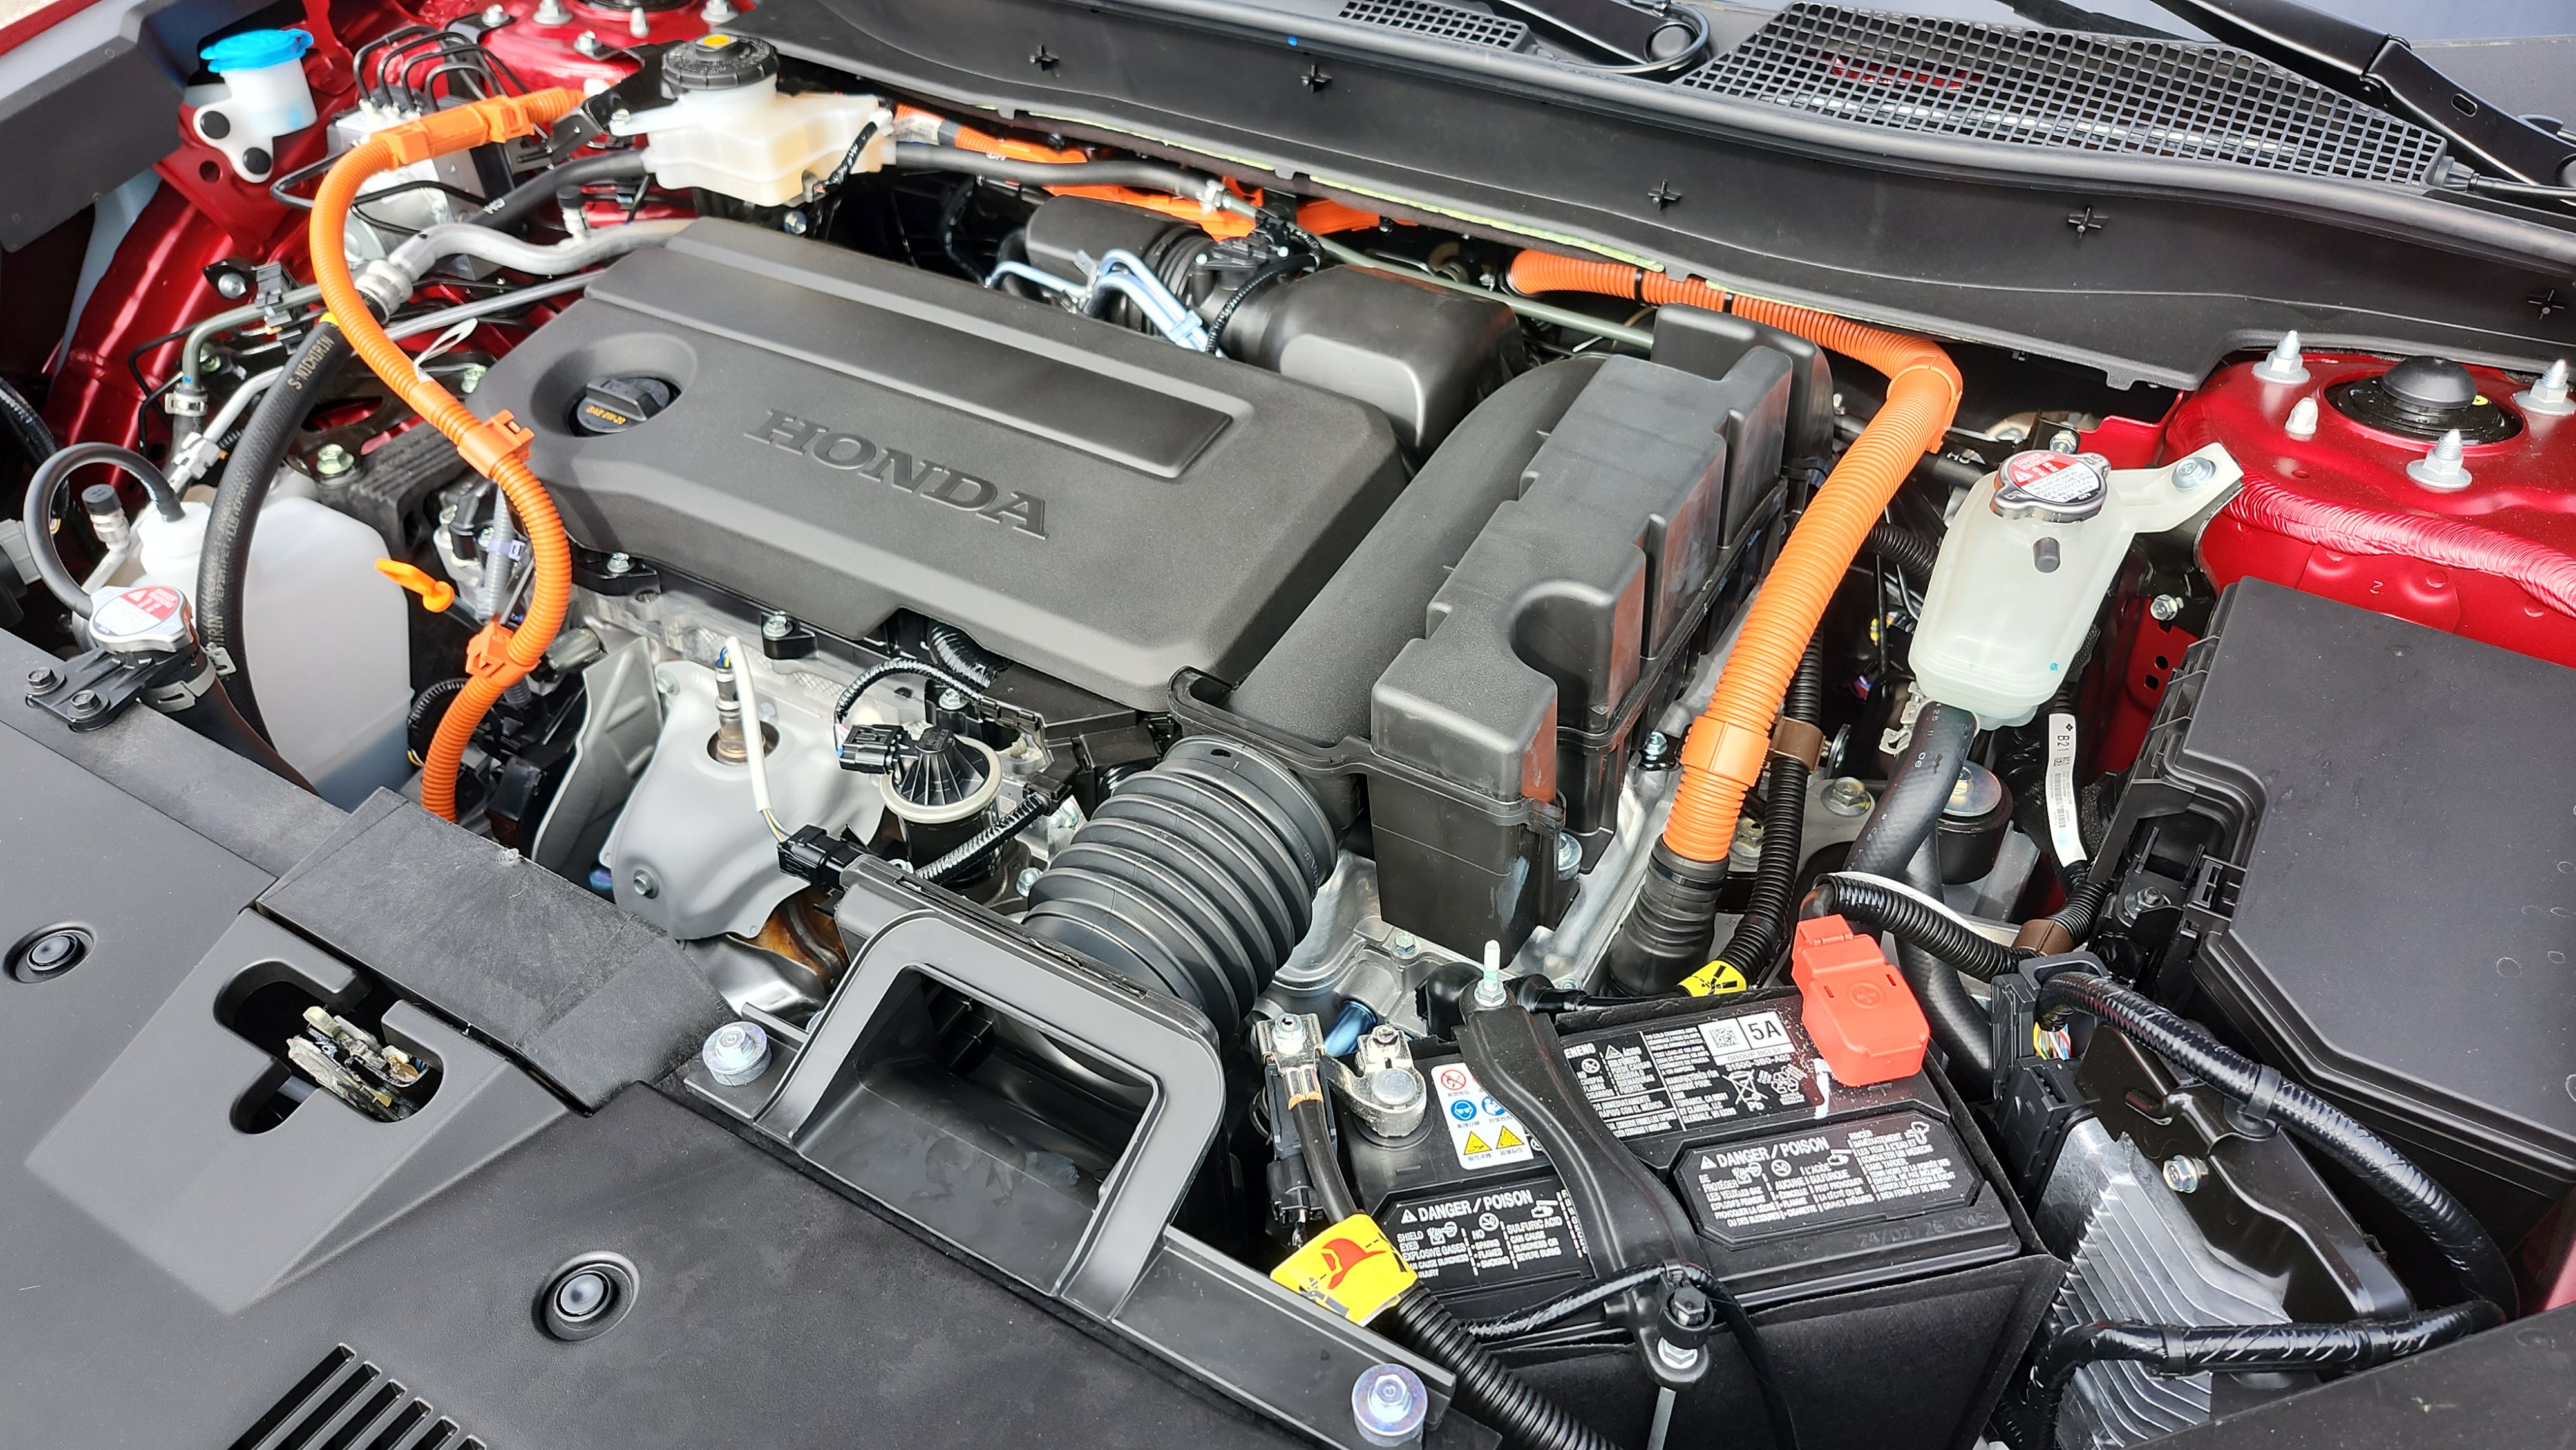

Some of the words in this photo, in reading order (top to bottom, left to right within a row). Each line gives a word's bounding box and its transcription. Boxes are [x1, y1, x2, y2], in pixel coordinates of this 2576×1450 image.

[743, 410, 1049, 540] HONDA
[2057, 735, 2070, 751] B21
[1748, 1020, 1781, 1040] 5A
[1564, 1043, 1596, 1059] ENENO
[1727, 1051, 1756, 1062] GROUP
[1629, 1061, 1653, 1071] CAUSAR
[1580, 1076, 1605, 1086] CHISPAS
[1665, 1071, 1707, 1085] MANUFACTURED
[1707, 1069, 1719, 1078] FOR
[1583, 1083, 1606, 1093] FLAMAS
[1704, 1095, 1713, 1103] CA
[1620, 1106, 1634, 1115] CON
[1678, 1107, 1687, 1116] BY
[1747, 1102, 1765, 1111] Pb
[1699, 1174, 1711, 1183] SE
[1775, 1176, 1806, 1191] AUCUNE
[1706, 1192, 1721, 1203] LES
[1719, 1189, 1739, 1200] YEUX
[1506, 1219, 1544, 1234] SULFURIC
[1544, 1216, 1563, 1229] ACID
[1397, 1230, 1424, 1242] SHIELD
[1472, 1229, 1485, 1240] NO
[1510, 1234, 1525, 1244] CAN
[1399, 1241, 1419, 1252] EYES
[1475, 1239, 1501, 1250] SPARKS
[1402, 1247, 1441, 1261] EXPLOSIVE
[1441, 1243, 1466, 1255] GASES
[1478, 1248, 1503, 1259] FLAMES
